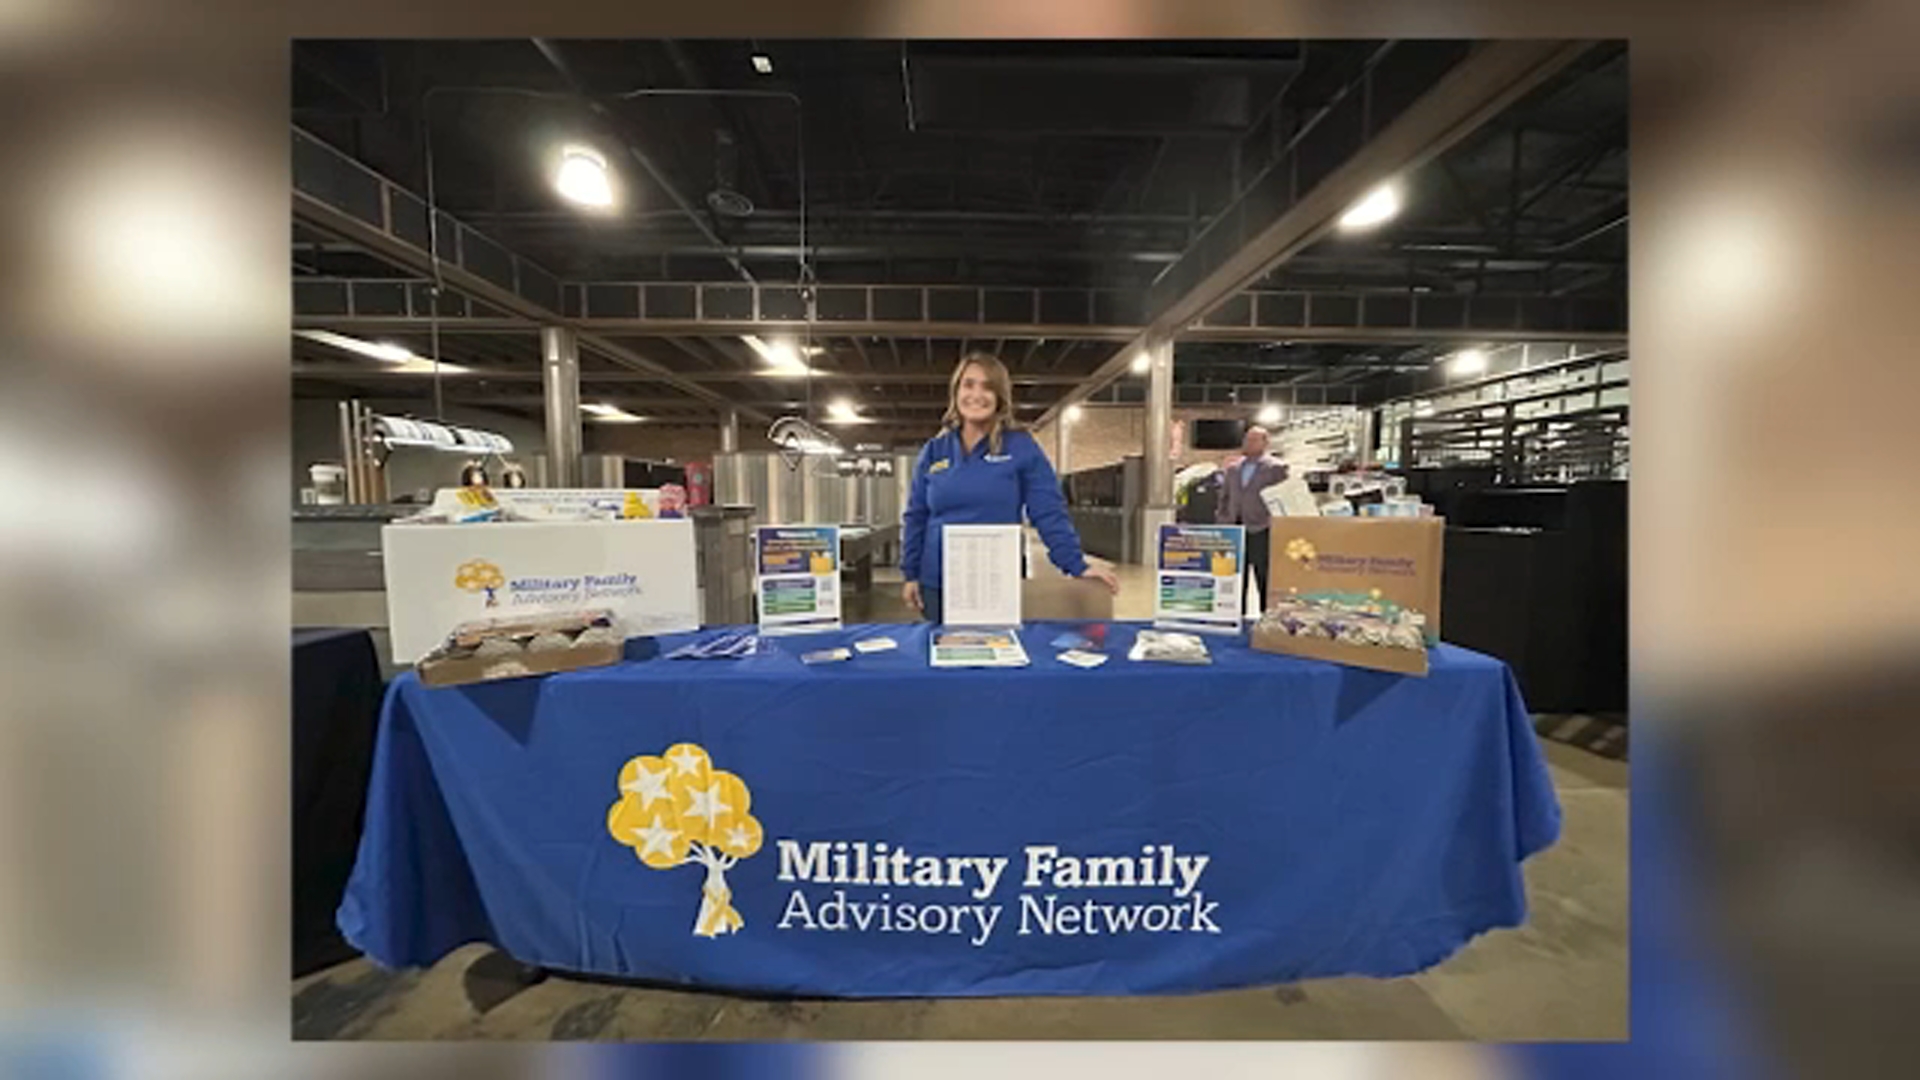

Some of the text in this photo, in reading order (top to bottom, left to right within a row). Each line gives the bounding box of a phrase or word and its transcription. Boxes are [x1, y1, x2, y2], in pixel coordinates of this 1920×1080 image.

[510, 577, 580, 591] Military
[777, 839, 1209, 898] Military Family
[777, 890, 1221, 946] Advisory Network
